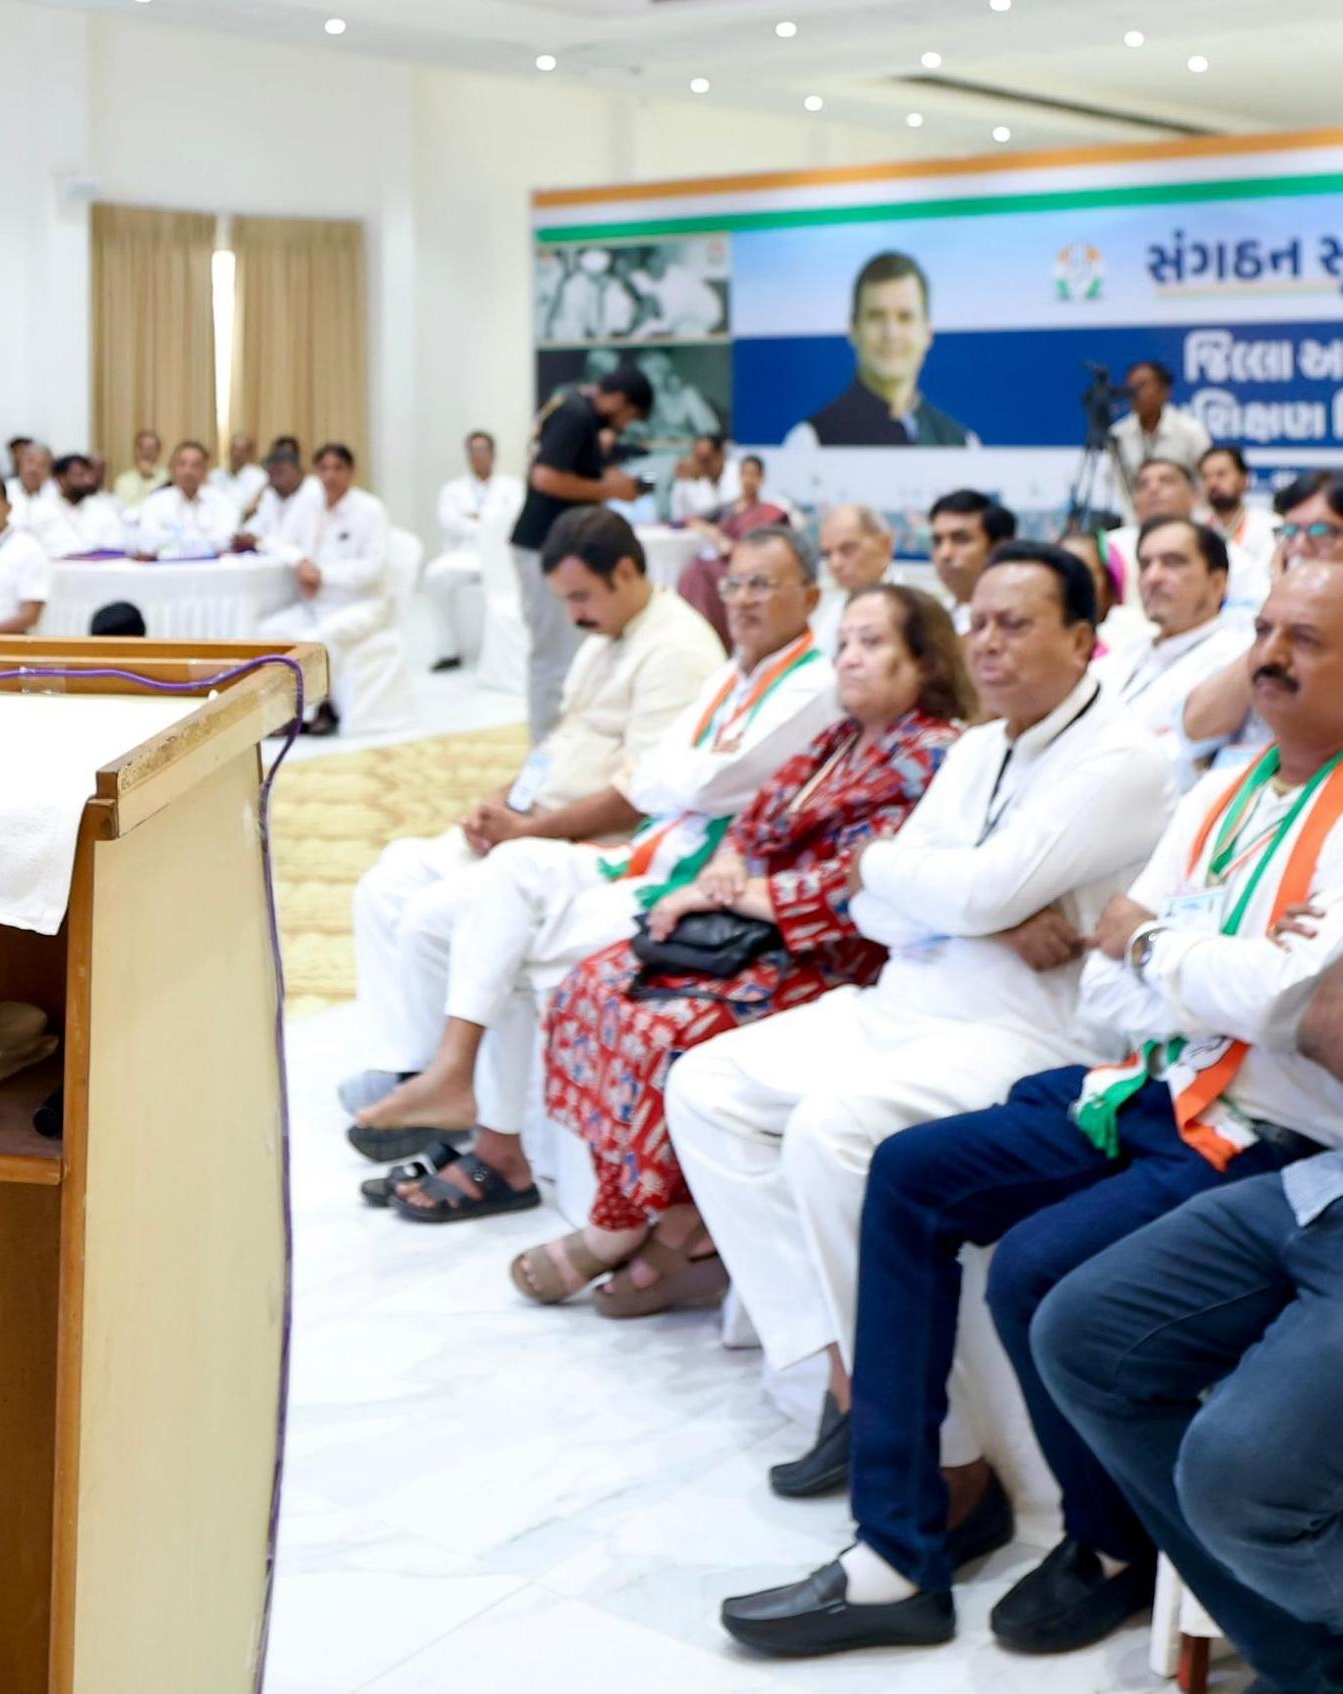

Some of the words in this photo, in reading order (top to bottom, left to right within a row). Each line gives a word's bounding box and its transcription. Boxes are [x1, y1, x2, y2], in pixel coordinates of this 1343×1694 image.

[1147, 229, 1300, 282] સંગઠન
[1184, 328, 1294, 382] જિલ્લા
[1182, 387, 1326, 442] શિક્ષણ
